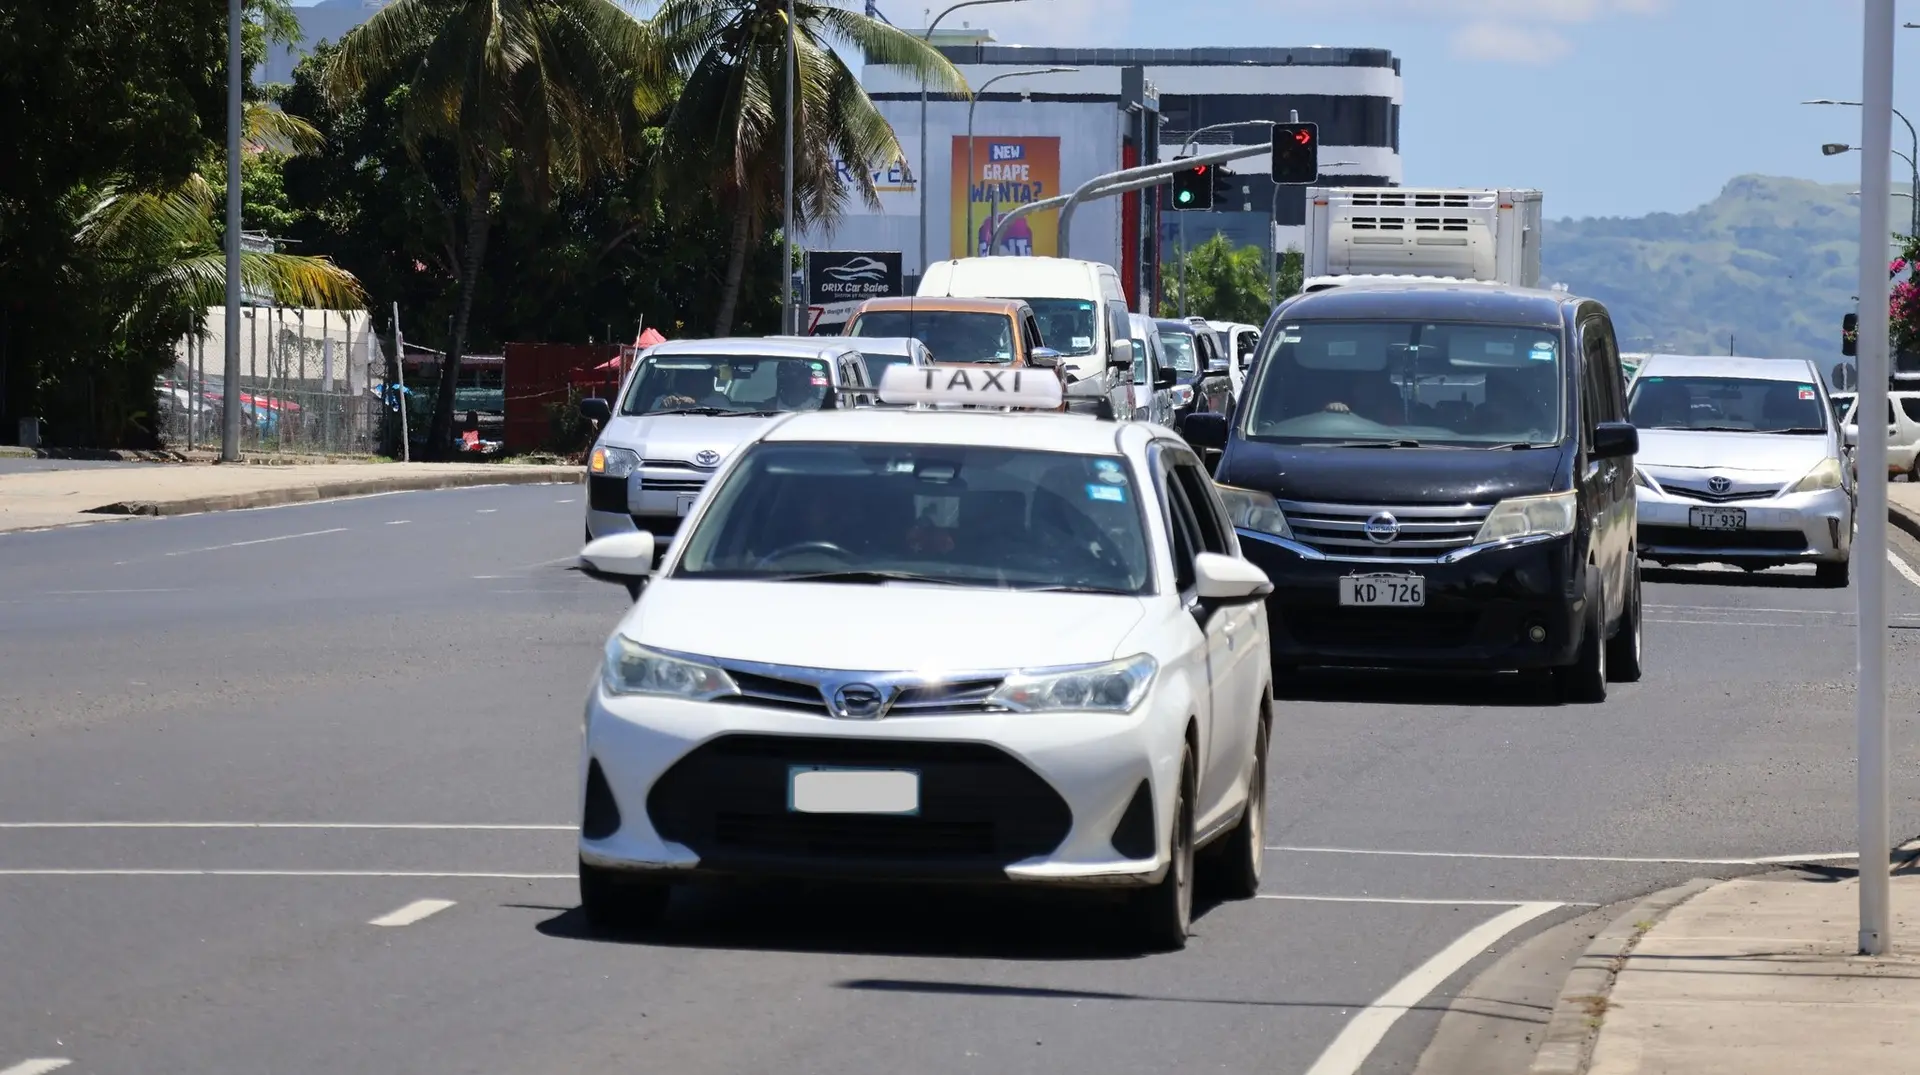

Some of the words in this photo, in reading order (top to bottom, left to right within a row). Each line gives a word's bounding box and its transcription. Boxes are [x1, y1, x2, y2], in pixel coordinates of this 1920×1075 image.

[993, 145, 1020, 160] NEW
[983, 164, 1030, 181] GRAPE
[971, 181, 1043, 203] WANTA?
[845, 283, 862, 293] Car
[863, 282, 889, 293] Sales
[918, 368, 1022, 393] TAXI
[1701, 514, 1715, 526] IT
[1721, 514, 1744, 528] 932
[1354, 584, 1377, 602] KD
[1388, 584, 1421, 602] 726
